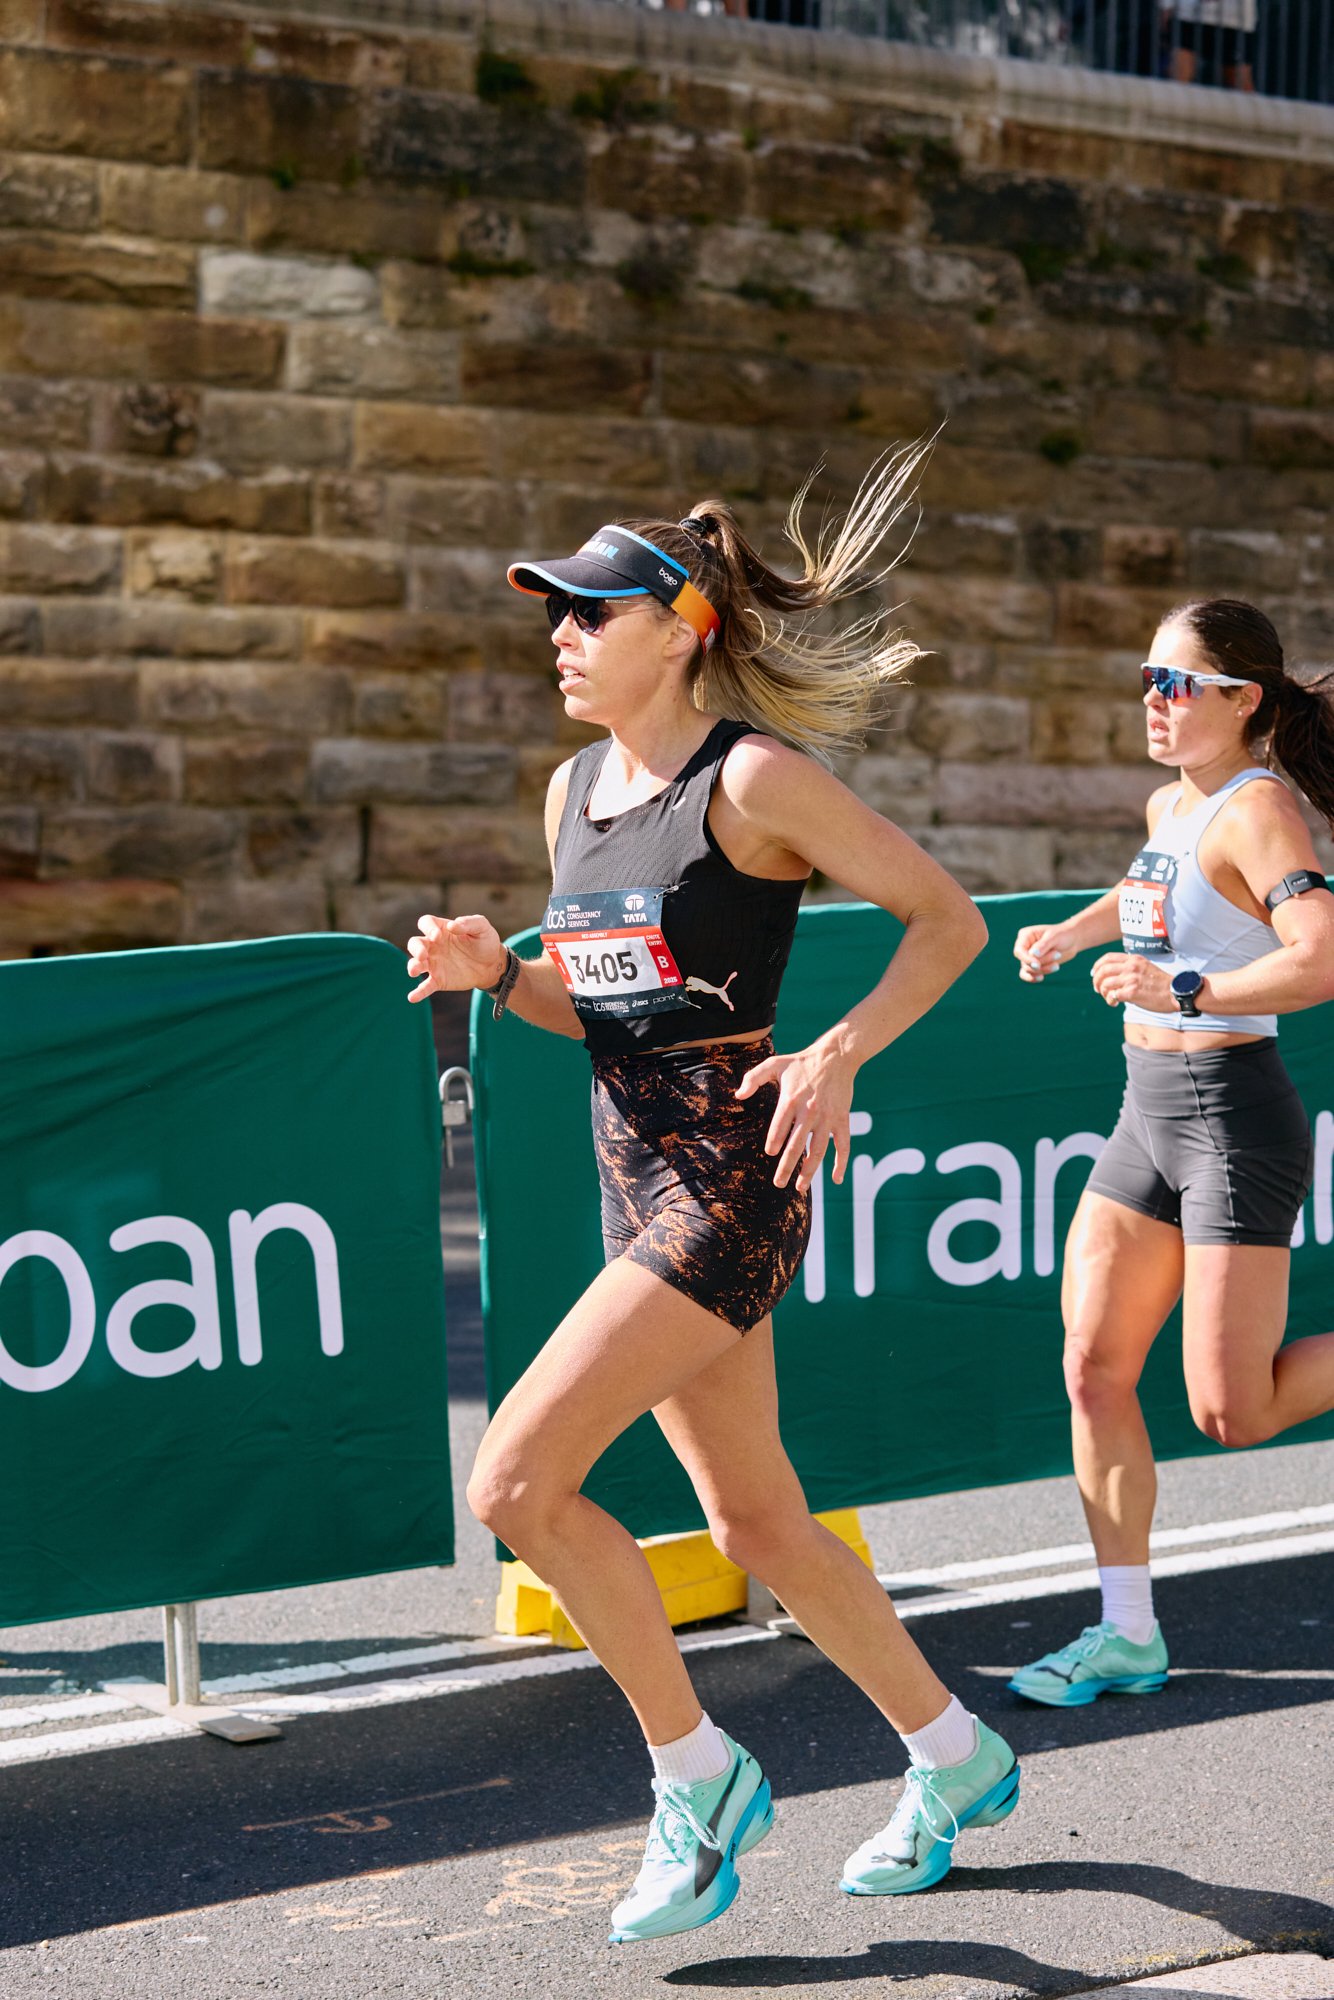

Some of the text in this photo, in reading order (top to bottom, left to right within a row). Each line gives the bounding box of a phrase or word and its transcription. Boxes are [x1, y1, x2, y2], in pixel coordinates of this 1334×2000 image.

[546, 906, 565, 929] tcs
[567, 910, 601, 920] CONSULTANCY
[622, 912, 647, 924] TATA
[567, 919, 590, 928] SERVICES
[570, 951, 638, 984] 3405
[657, 956, 669, 968] B
